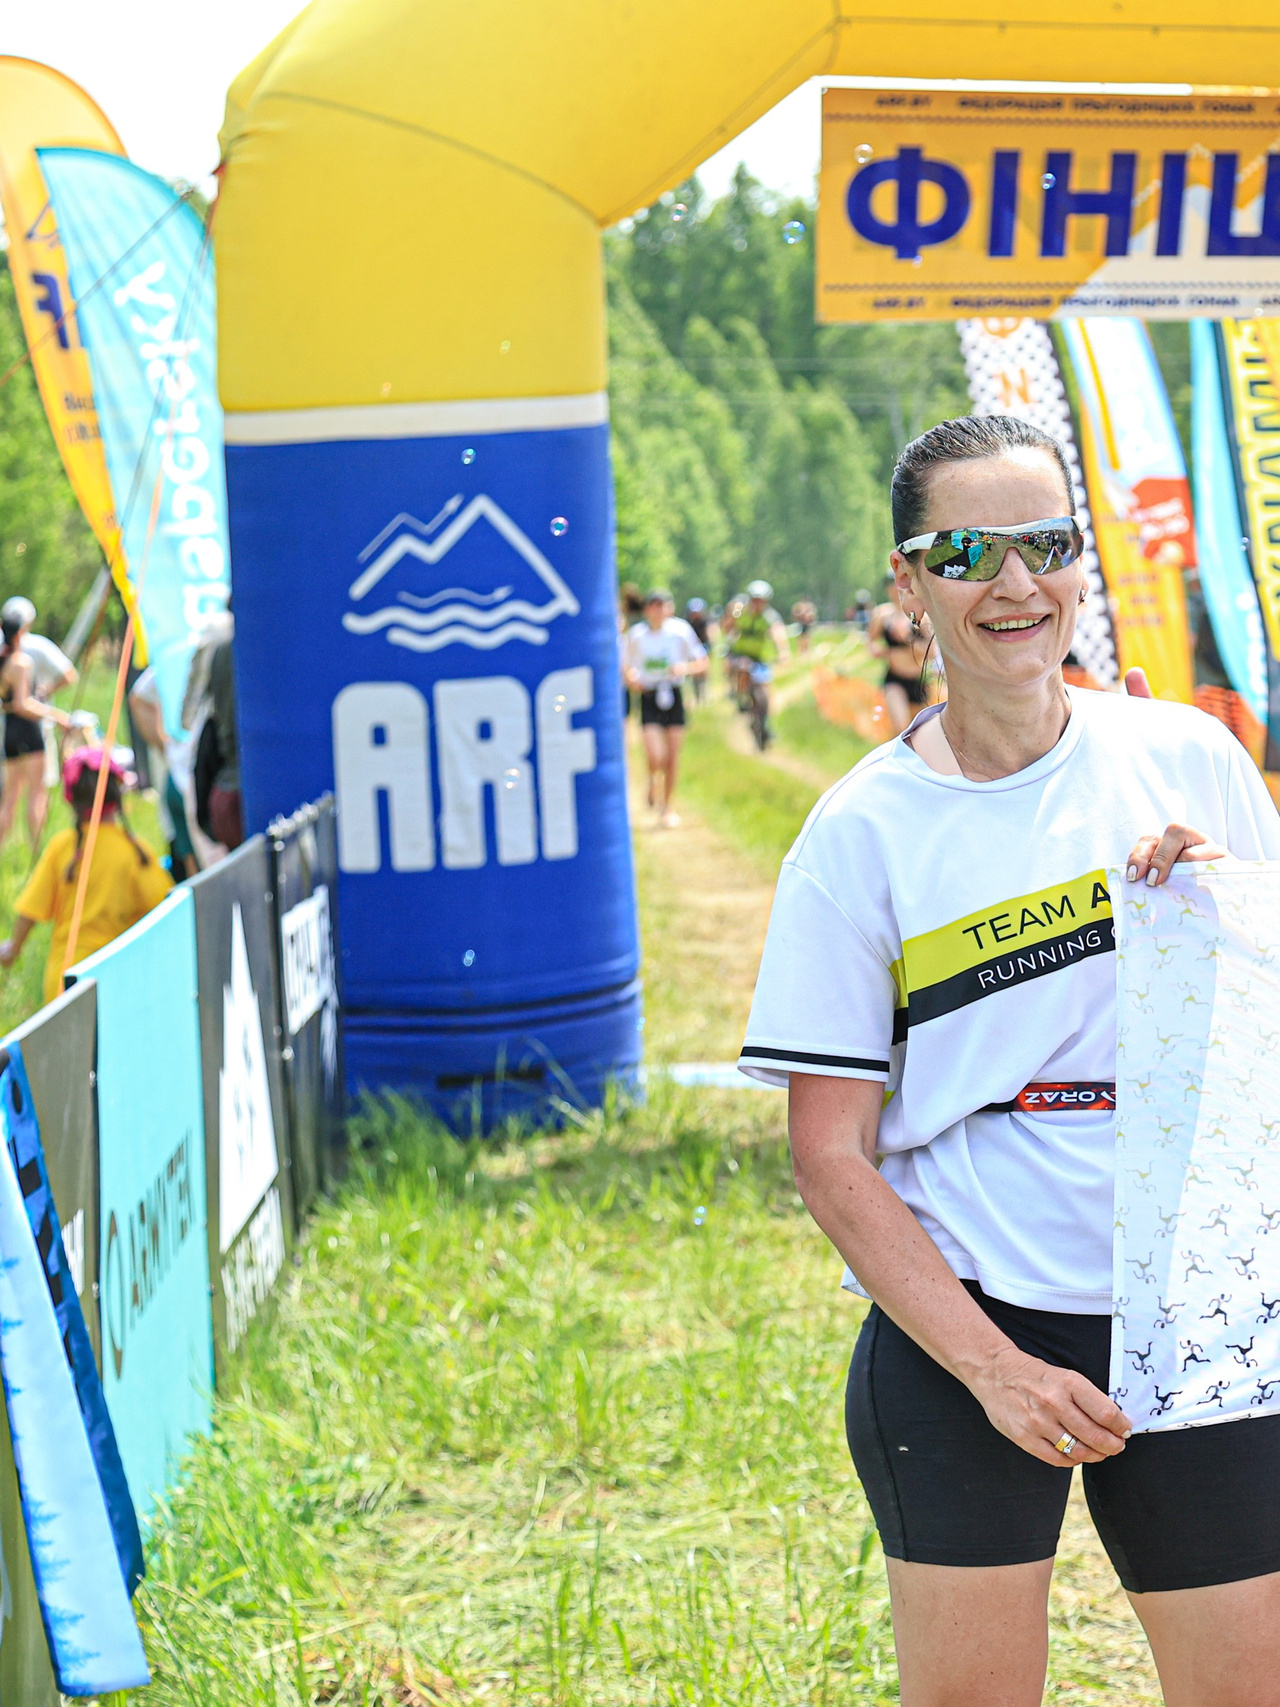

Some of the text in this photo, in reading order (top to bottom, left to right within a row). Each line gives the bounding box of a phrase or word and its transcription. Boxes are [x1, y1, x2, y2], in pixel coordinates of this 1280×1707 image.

[332, 666, 596, 873] ARF
[962, 895, 1076, 949] TEAM
[977, 929, 1102, 989] RUNNING
